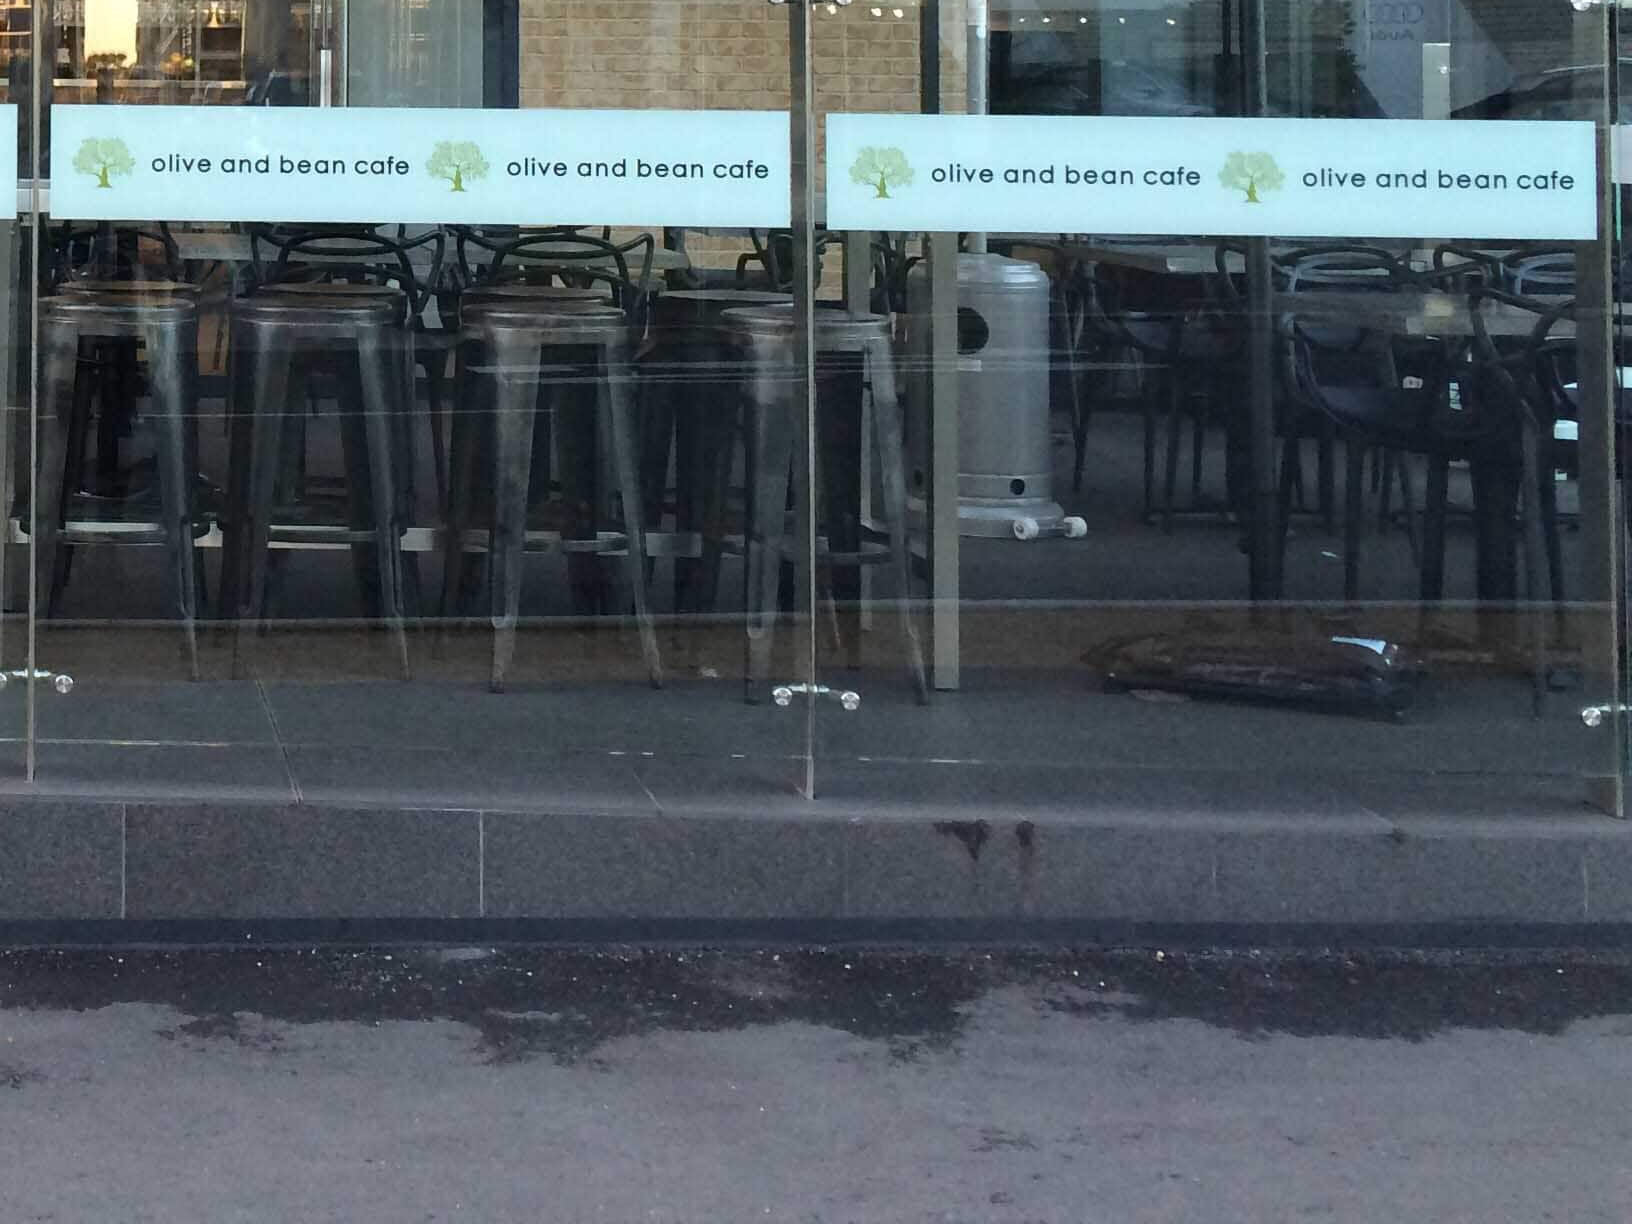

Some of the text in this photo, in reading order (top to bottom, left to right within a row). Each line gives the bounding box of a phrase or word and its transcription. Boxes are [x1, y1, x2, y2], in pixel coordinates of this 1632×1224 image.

[151, 154, 410, 175] olive and bean cafe
[506, 157, 769, 179] olive and bean cafe
[931, 163, 1201, 186] olive and bean cafe
[1302, 167, 1575, 190] olive and bean cafe
